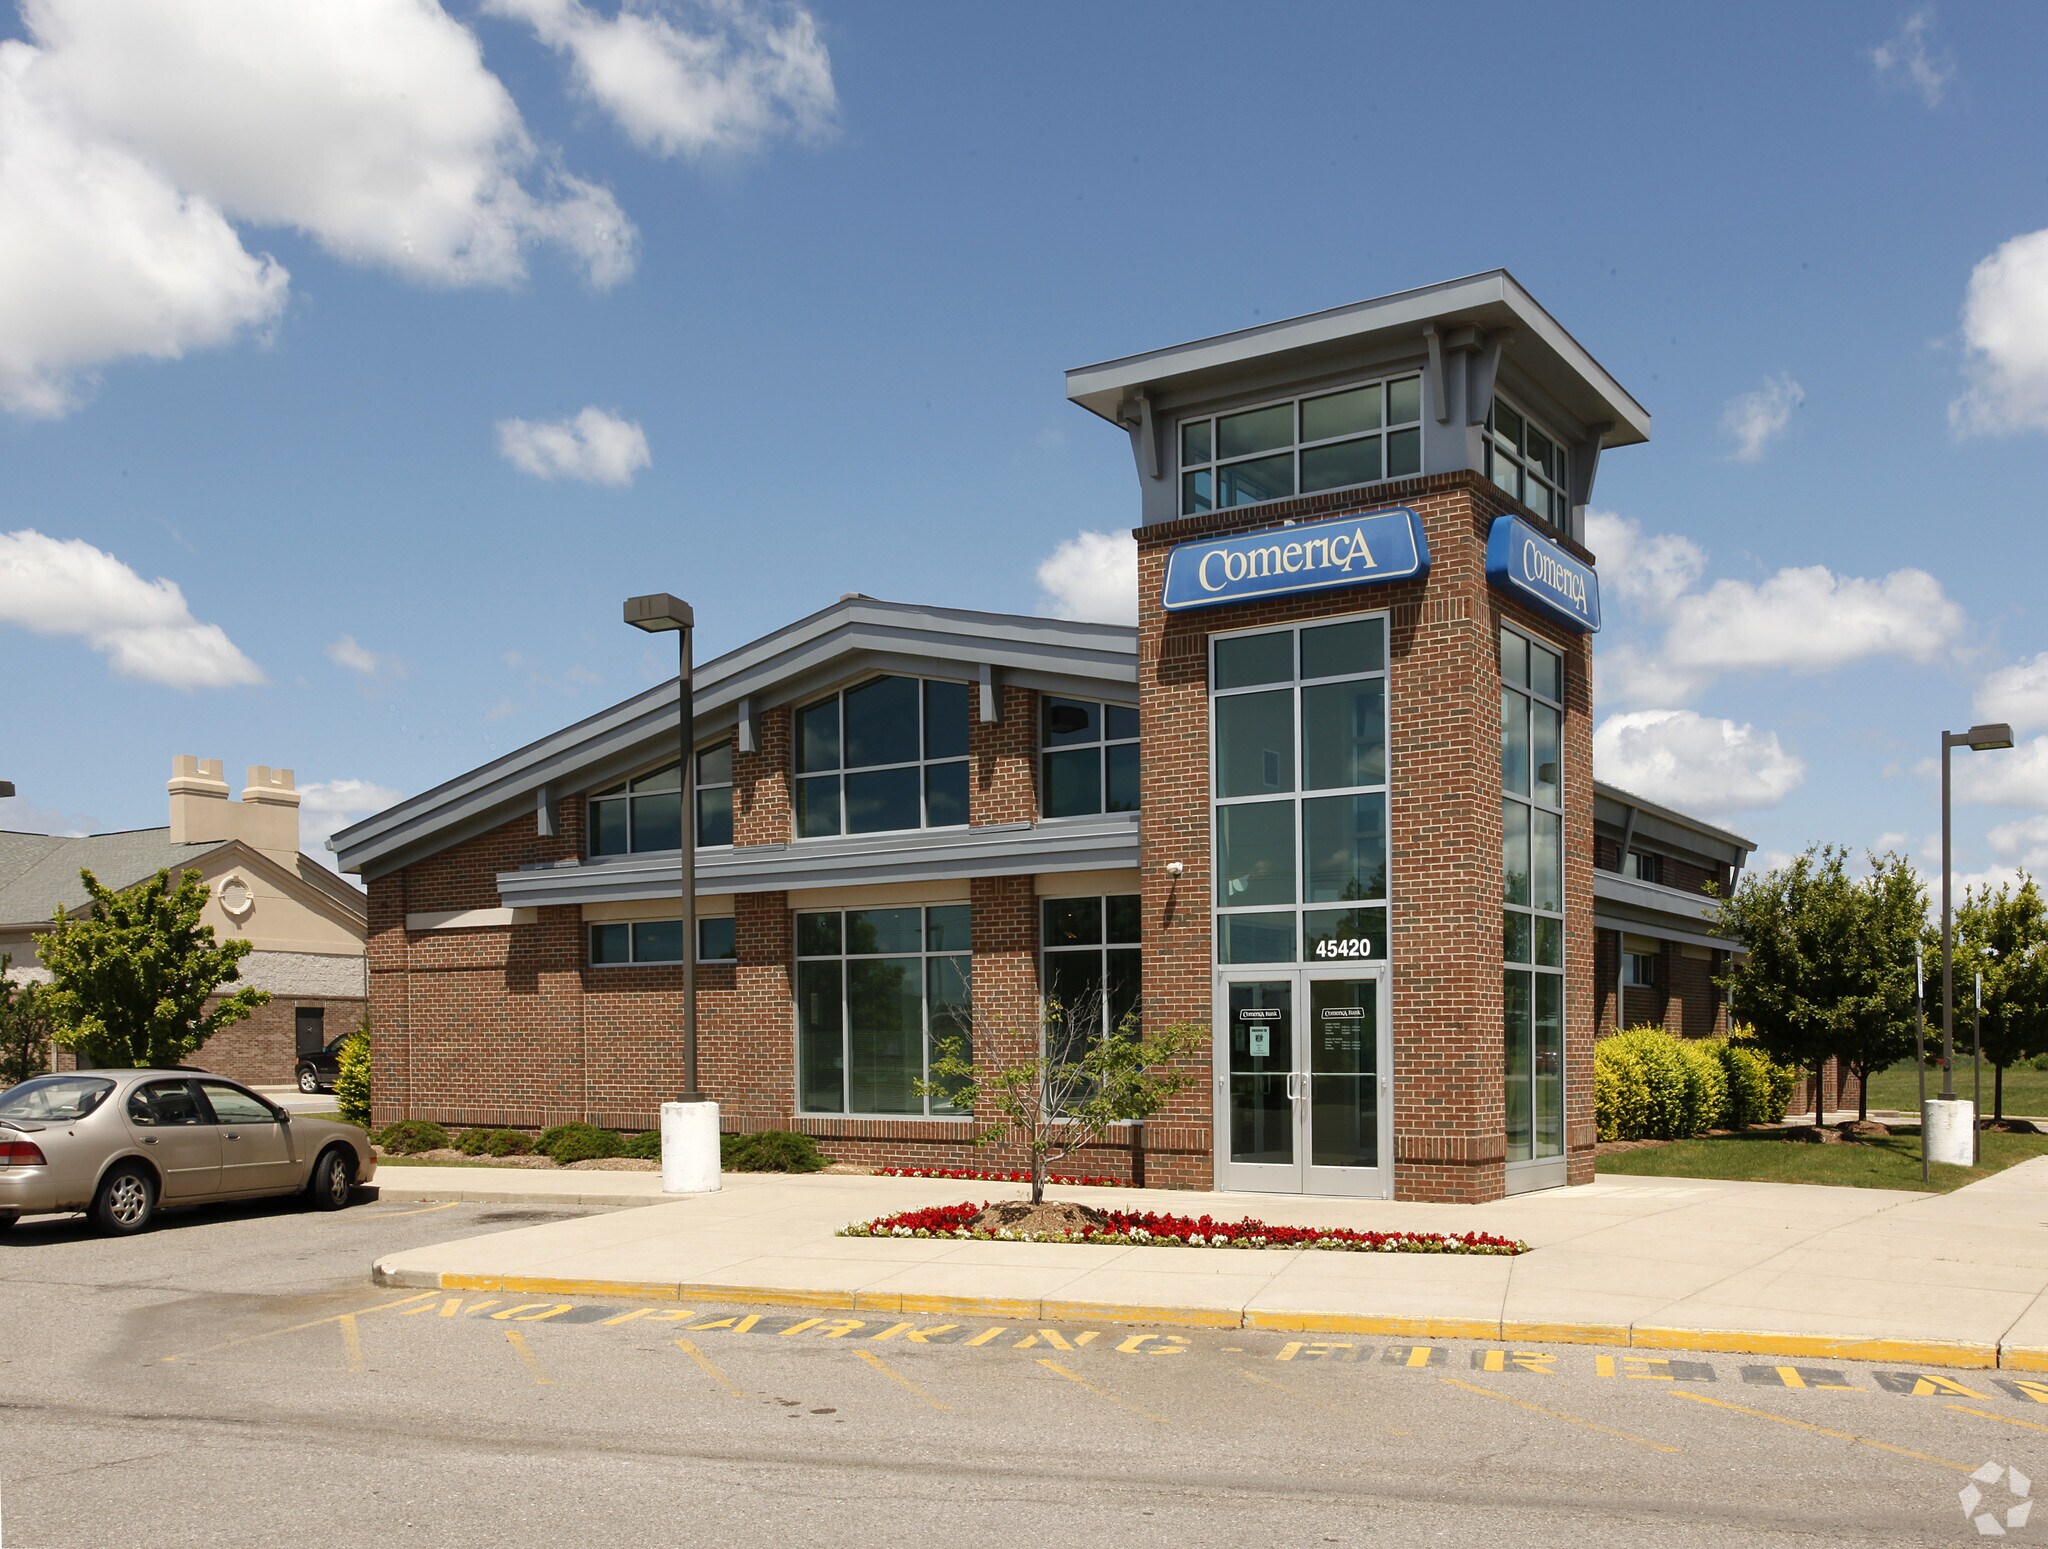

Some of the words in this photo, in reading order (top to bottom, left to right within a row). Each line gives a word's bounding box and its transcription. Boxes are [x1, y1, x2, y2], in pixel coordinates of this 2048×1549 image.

[1315, 938, 1371, 958] 45420
[401, 1297, 574, 1321] NO
[602, 1306, 1192, 1355] PARKING
[1275, 1341, 1676, 1381] FIRE
